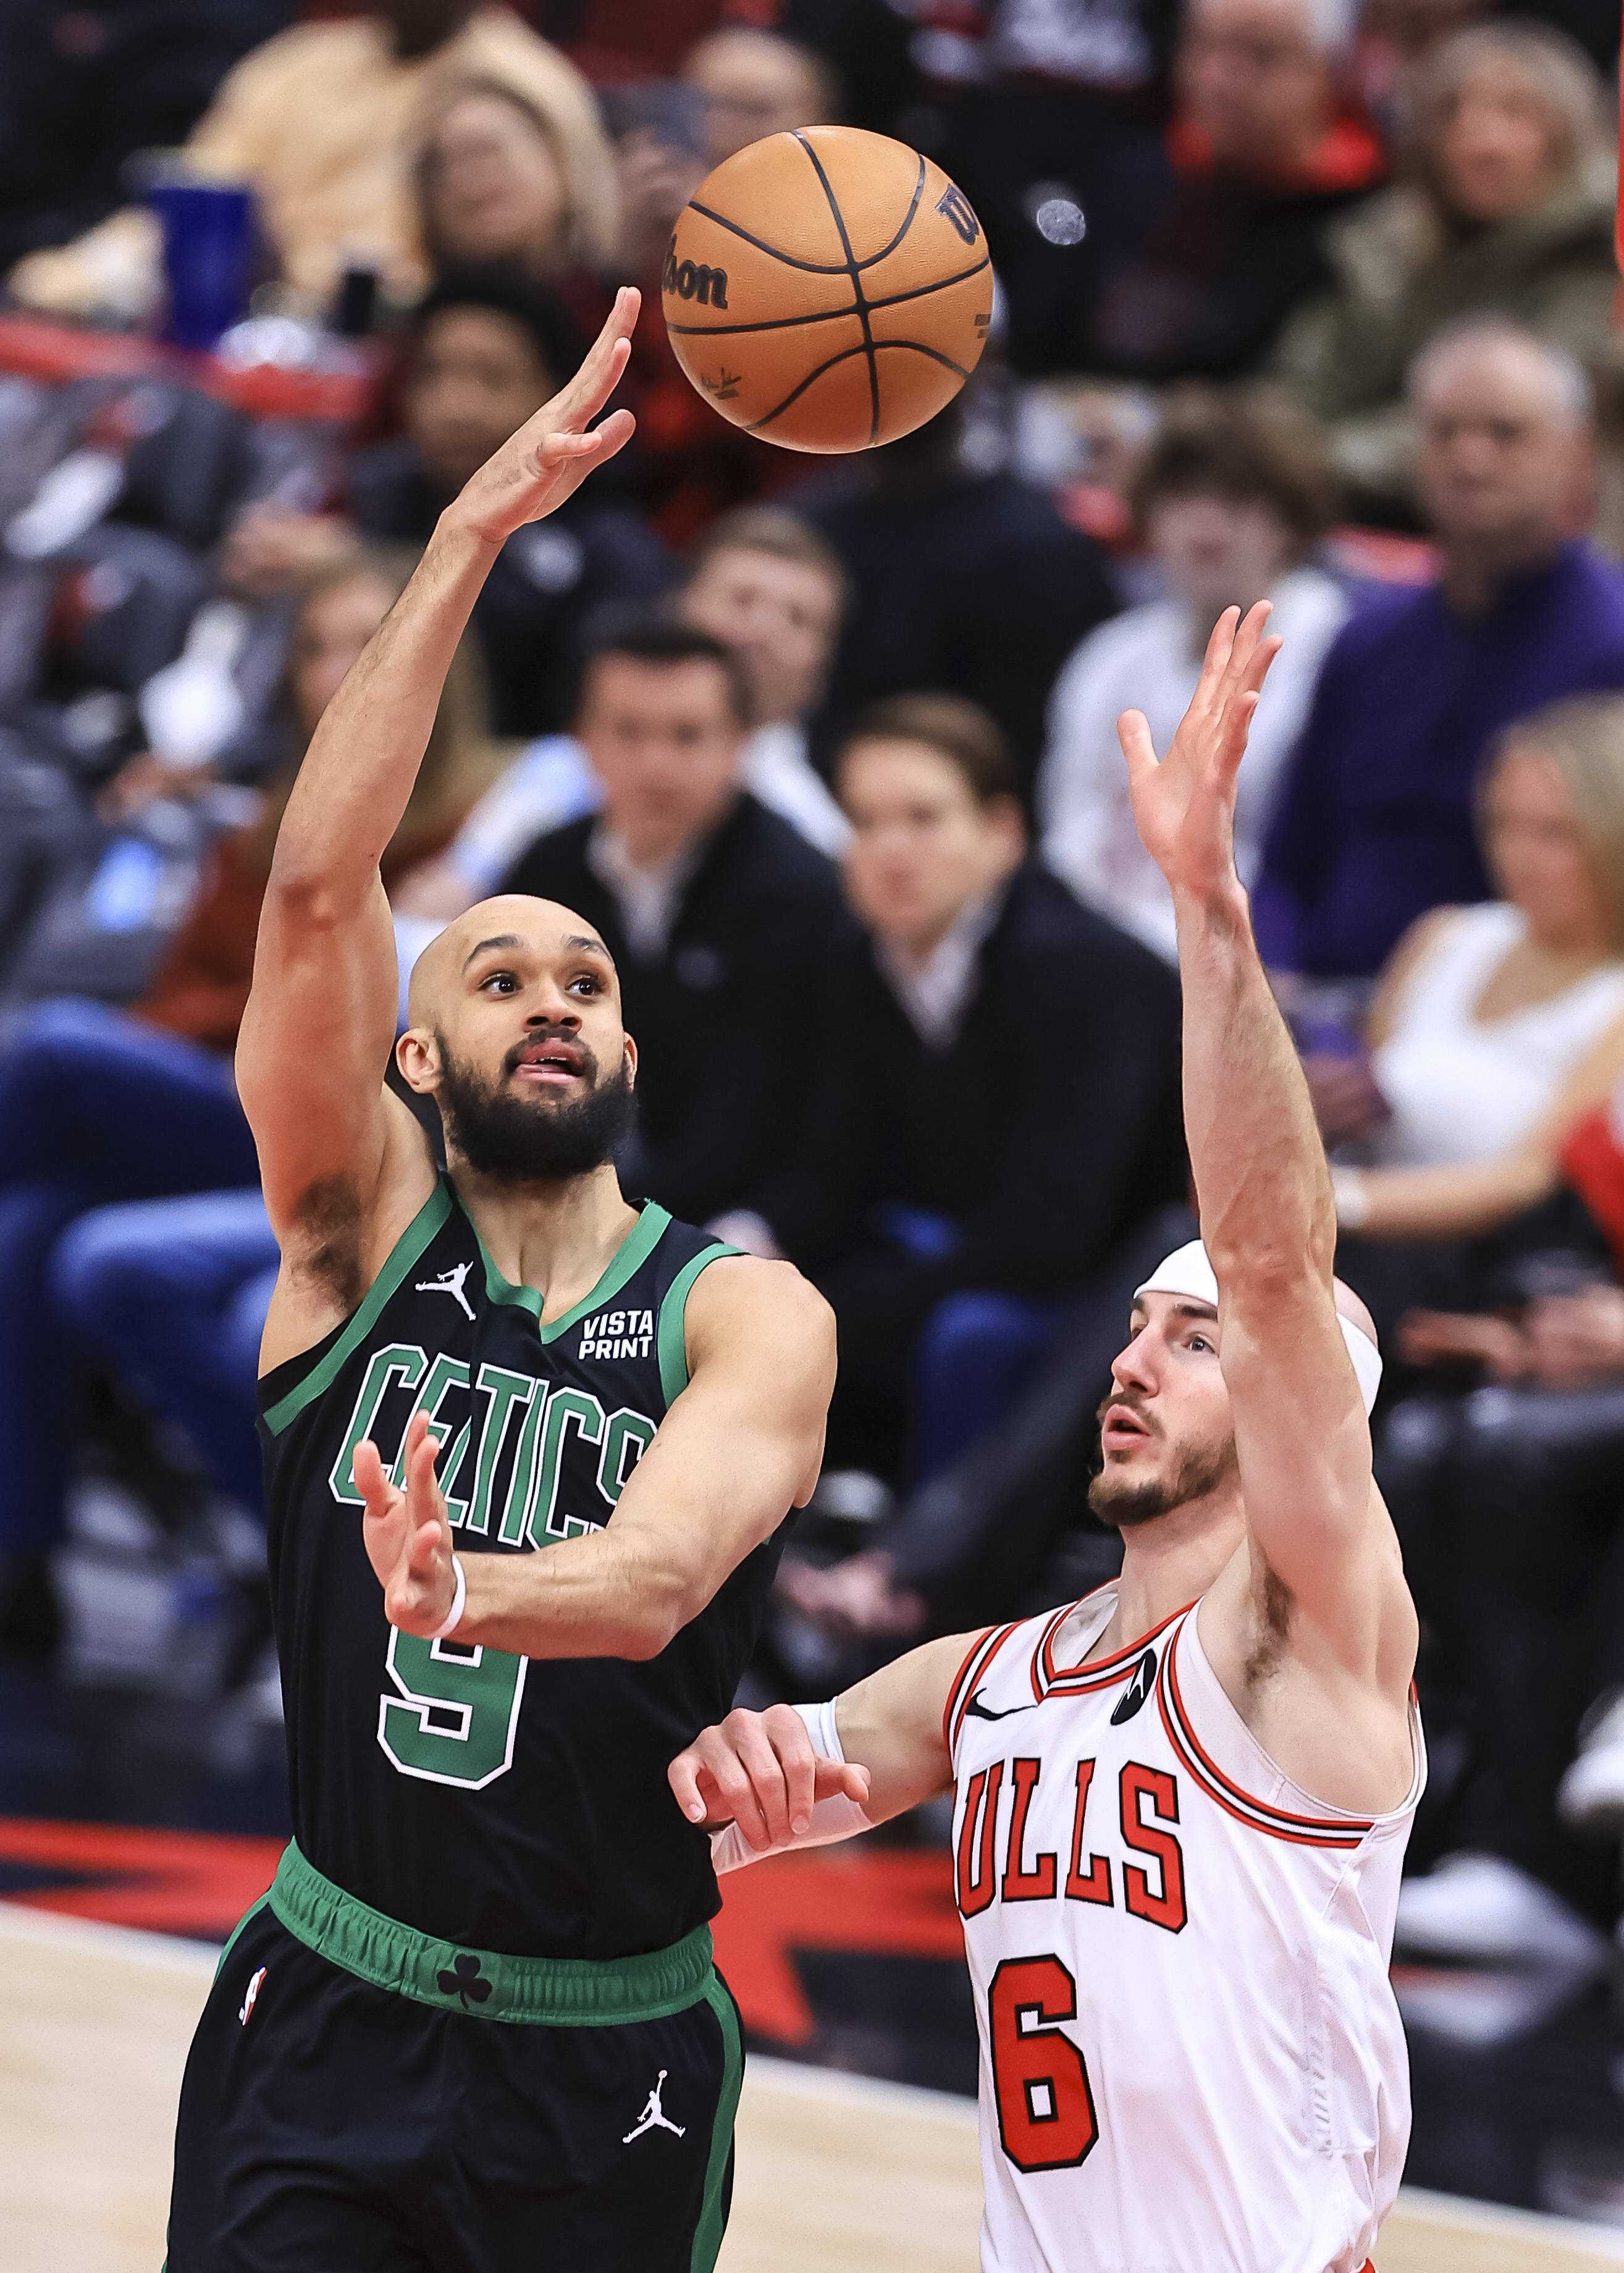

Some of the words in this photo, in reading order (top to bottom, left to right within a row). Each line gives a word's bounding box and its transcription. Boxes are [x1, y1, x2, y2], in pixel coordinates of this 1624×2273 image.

[578, 1335, 654, 1360] PRINT
[582, 1309, 653, 1339] VISTA
[952, 1757, 1188, 1935] ULLS
[988, 1952, 1100, 2174] 6
